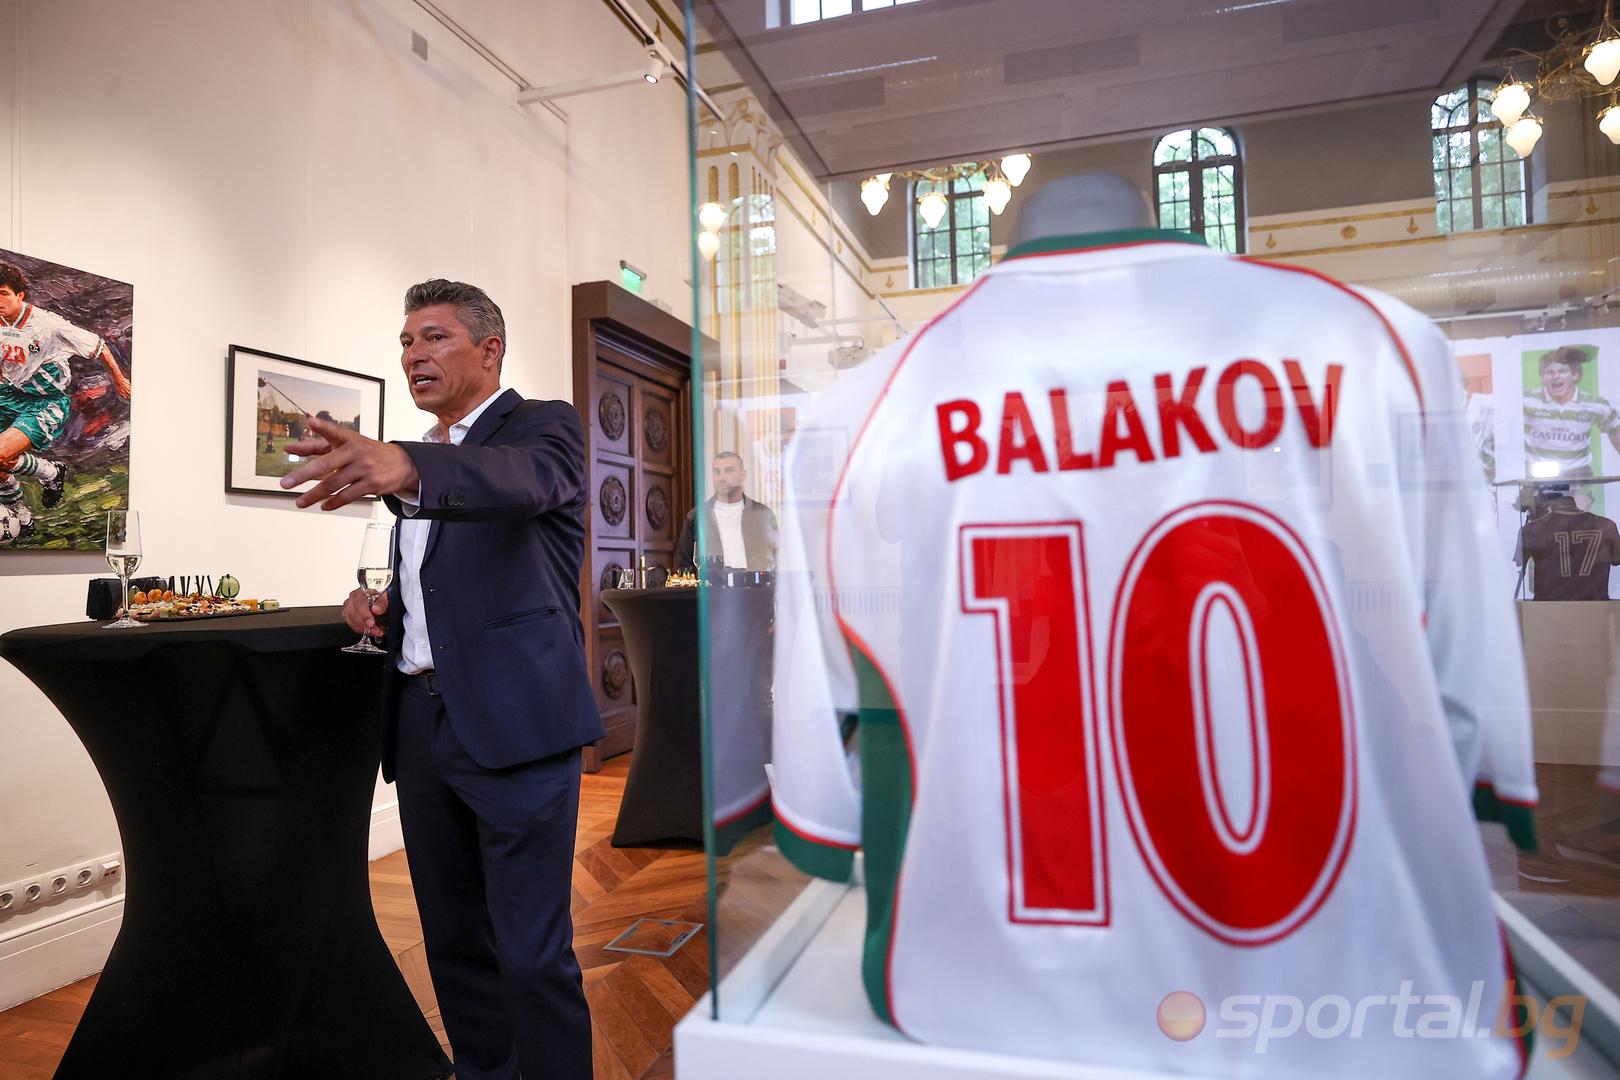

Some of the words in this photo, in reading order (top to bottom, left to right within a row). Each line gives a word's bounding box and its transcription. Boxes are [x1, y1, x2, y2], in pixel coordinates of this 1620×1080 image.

[936, 358, 1344, 482] BALAKOV
[1555, 530, 1602, 577] 17
[959, 498, 1358, 948] 10
